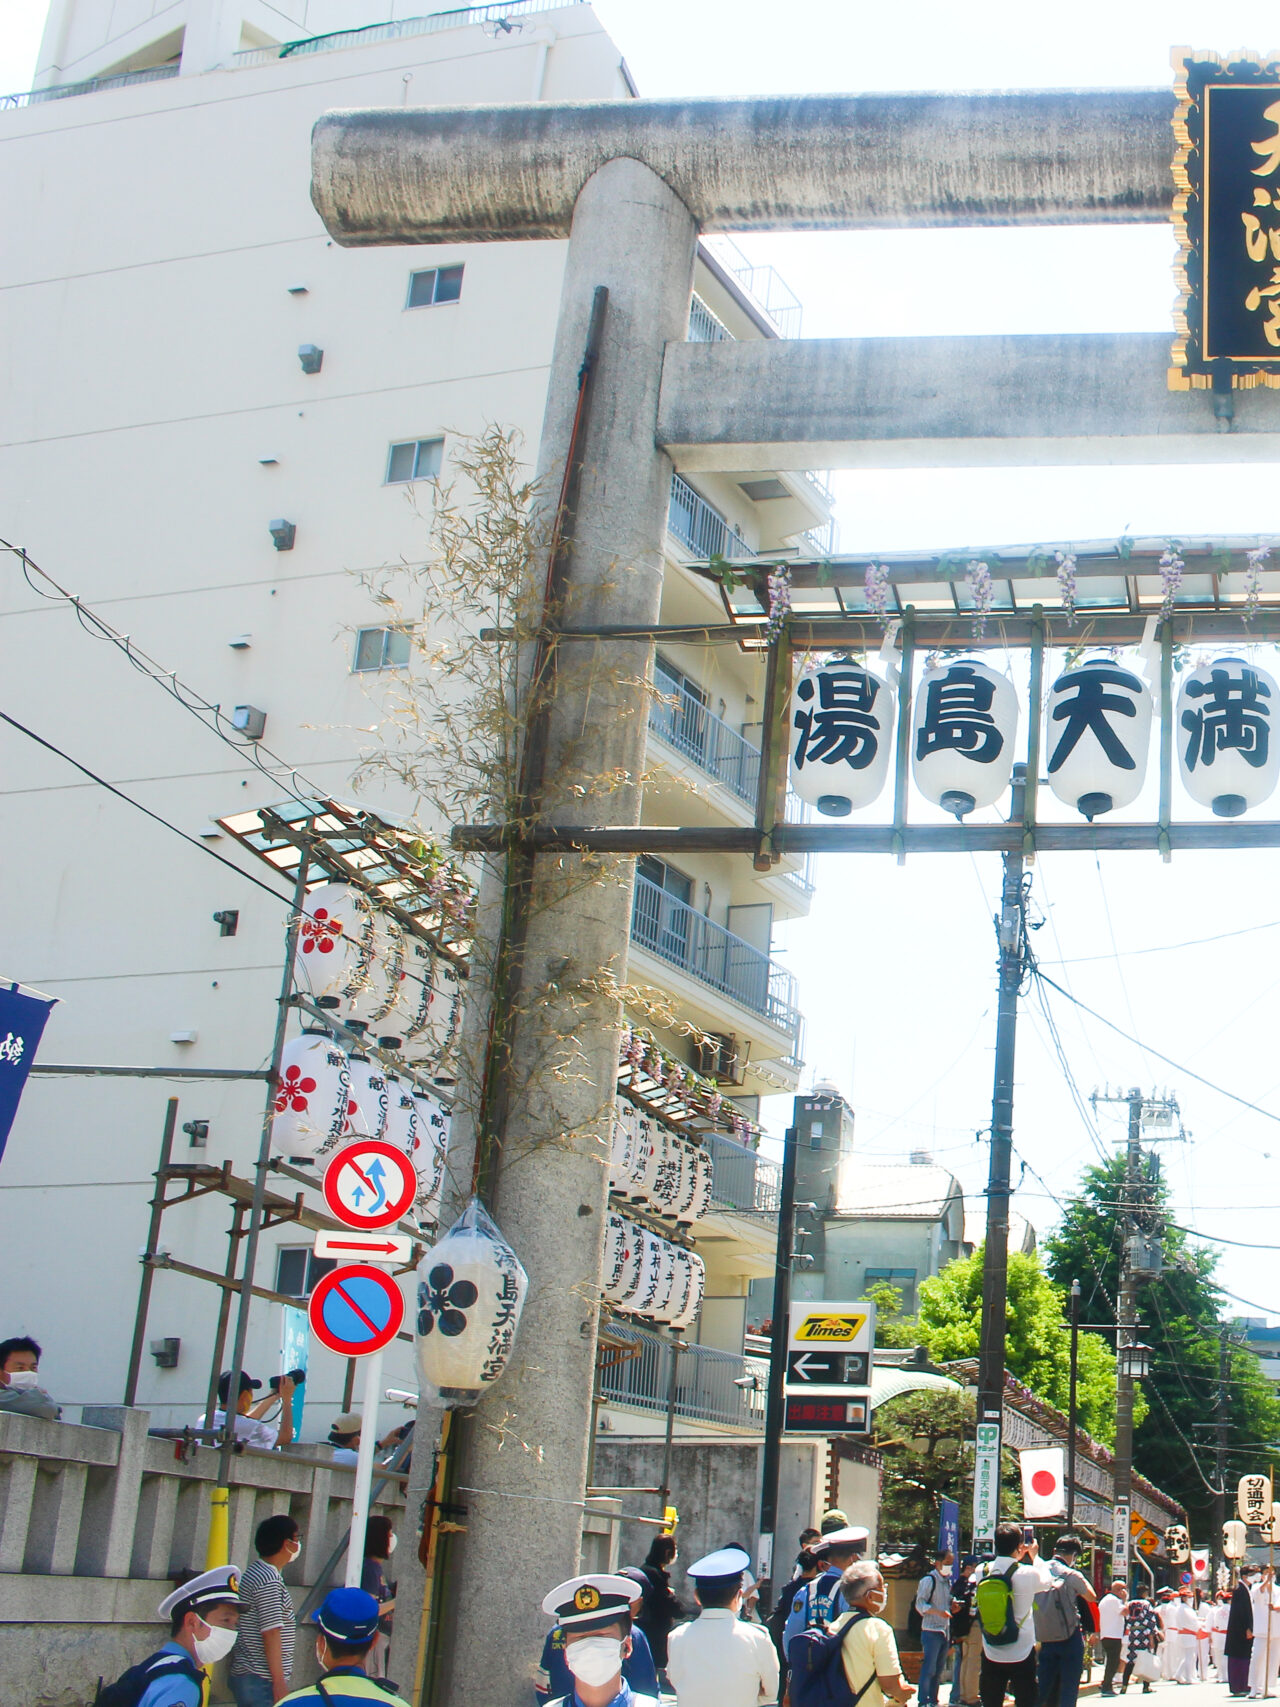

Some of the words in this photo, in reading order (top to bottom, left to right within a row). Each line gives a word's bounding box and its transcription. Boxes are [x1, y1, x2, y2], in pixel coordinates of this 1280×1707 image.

[805, 1324, 853, 1337] Times
[843, 1355, 863, 1383] P
[1247, 1477, 1265, 1521] 切通町会
